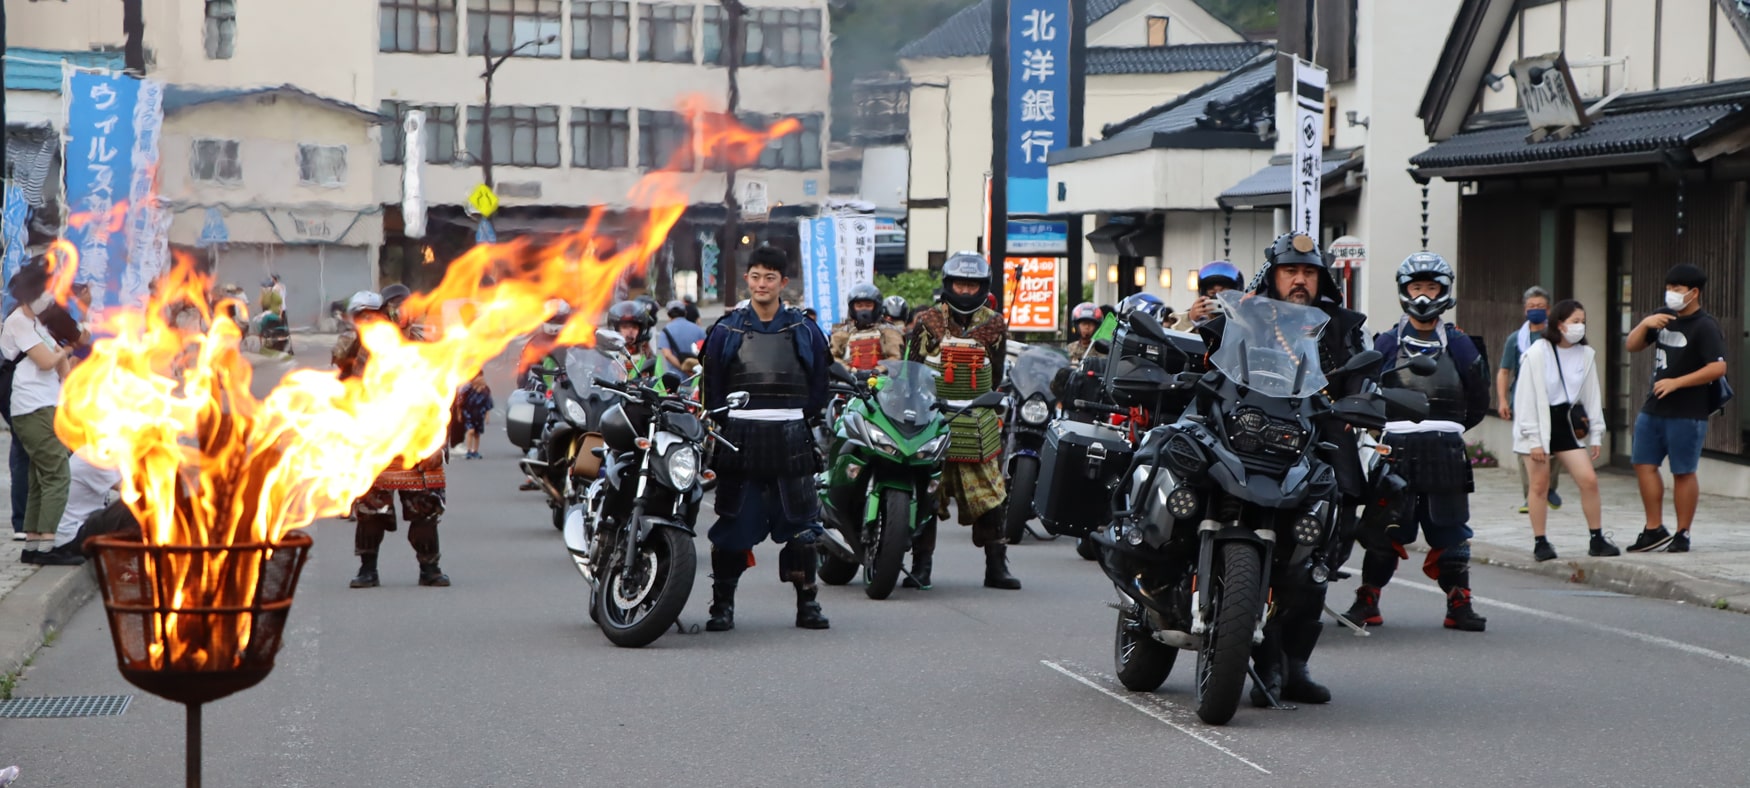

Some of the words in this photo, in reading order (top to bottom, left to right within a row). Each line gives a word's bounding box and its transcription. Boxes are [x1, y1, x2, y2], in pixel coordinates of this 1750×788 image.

[1020, 8, 1057, 164] 北洋銀行
[855, 236, 866, 284] 城下時代
[1018, 291, 1053, 303] CHEF
[1019, 276, 1054, 291] HOT
